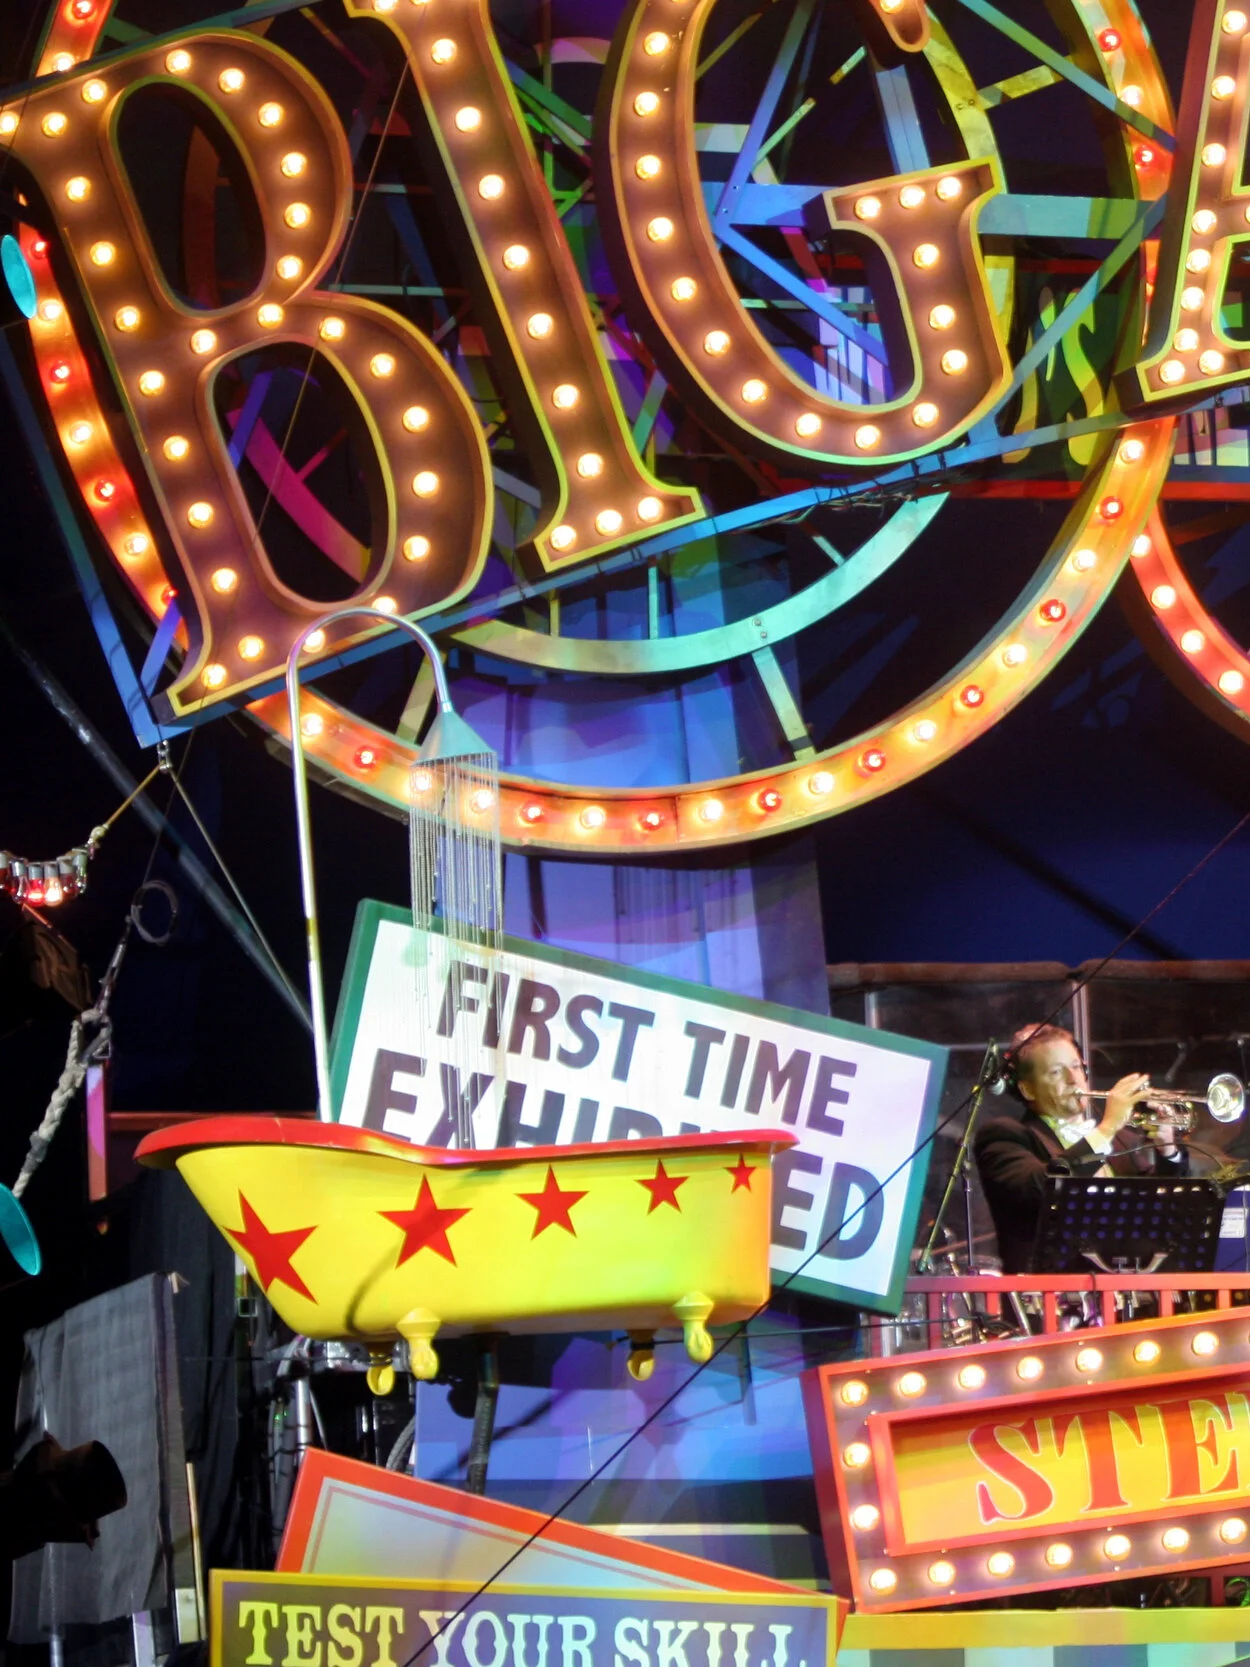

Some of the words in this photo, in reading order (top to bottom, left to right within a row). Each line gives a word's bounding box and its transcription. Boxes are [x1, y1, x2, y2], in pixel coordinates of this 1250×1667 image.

[0, 0, 1012, 717] BIG
[436, 960, 655, 1083] FIRST
[683, 1021, 857, 1137] TIME
[238, 1601, 406, 1667] TEST
[419, 1610, 599, 1667] YOUR
[614, 1617, 808, 1667] SKILL
